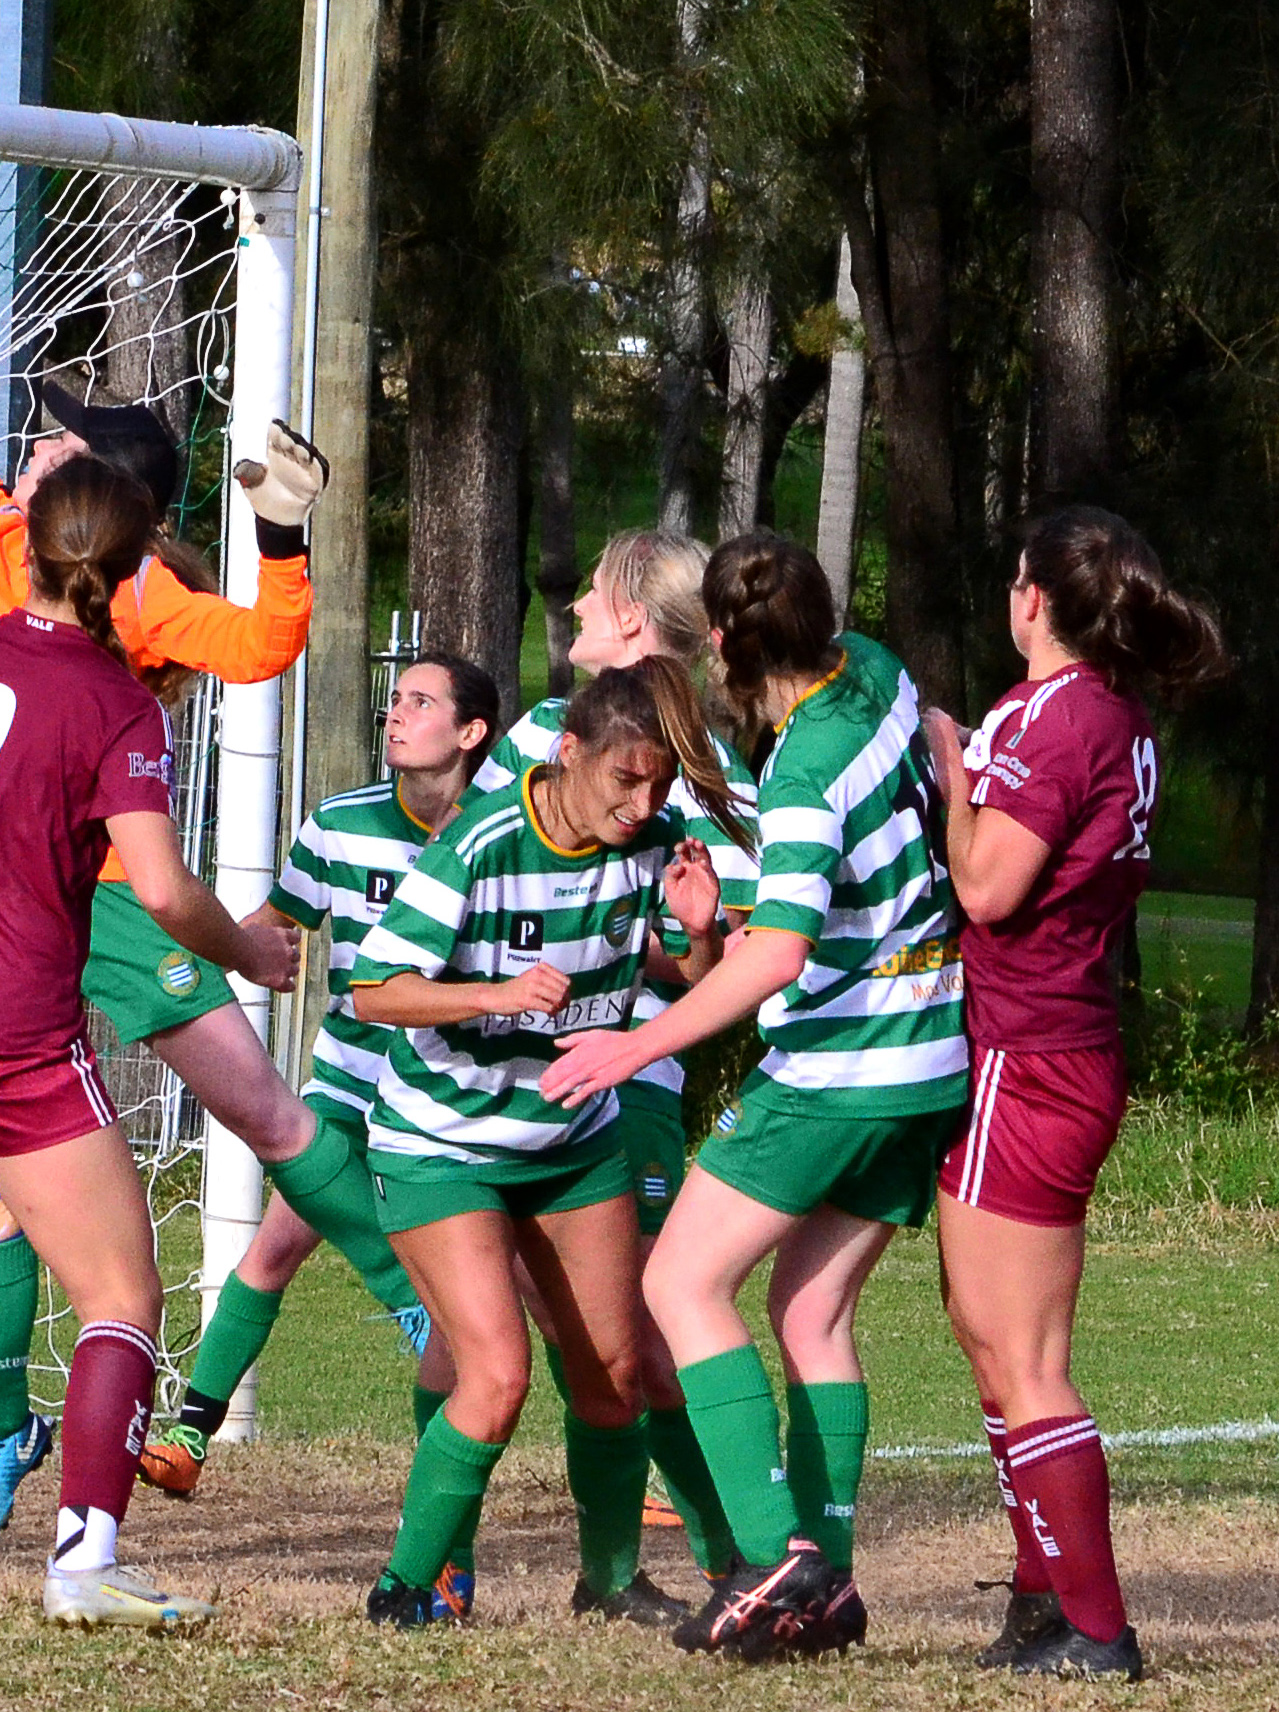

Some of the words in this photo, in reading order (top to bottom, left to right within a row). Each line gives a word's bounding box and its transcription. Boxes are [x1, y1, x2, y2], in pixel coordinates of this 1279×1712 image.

[26, 614, 55, 632] VALE
[520, 920, 536, 946] P
[993, 1456, 1018, 1508] VALE
[1024, 1499, 1062, 1557] VALE
